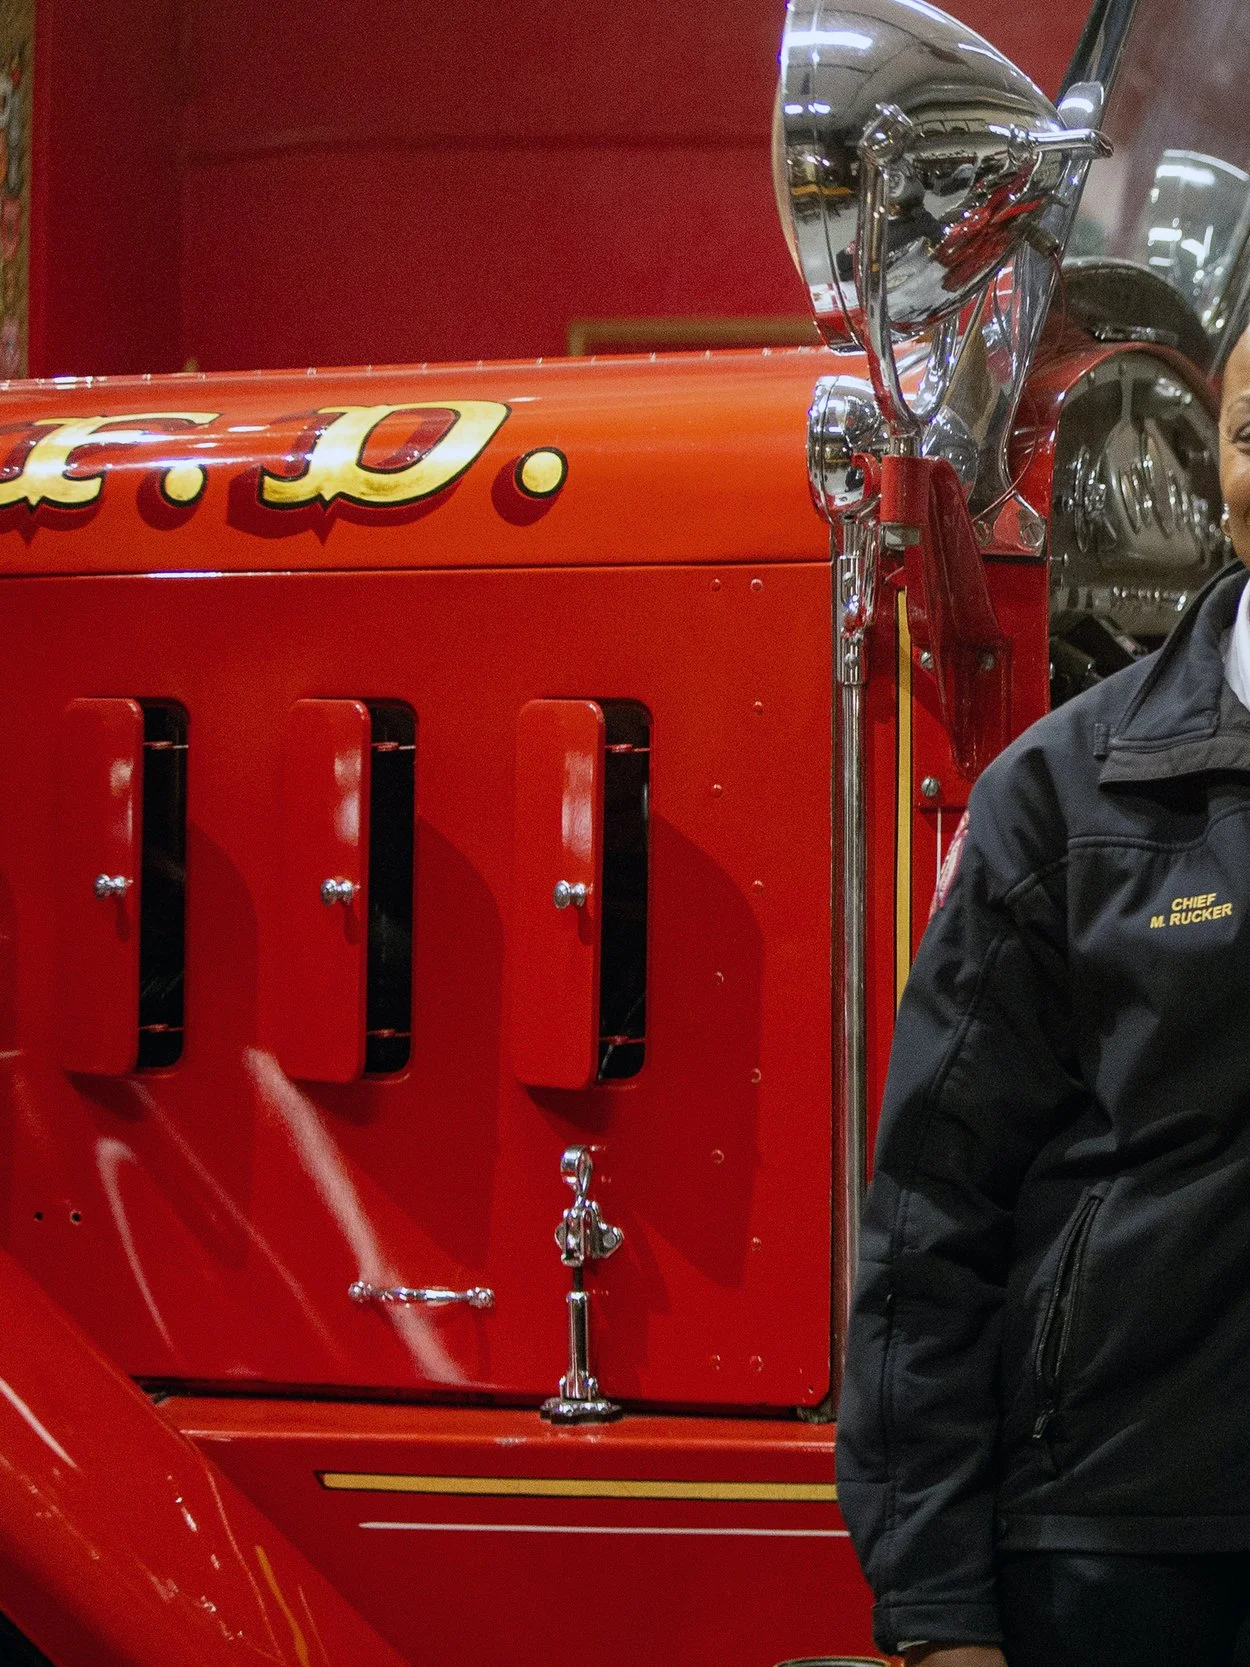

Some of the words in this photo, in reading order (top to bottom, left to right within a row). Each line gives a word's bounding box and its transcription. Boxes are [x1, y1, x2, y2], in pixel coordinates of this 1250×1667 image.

[1171, 892, 1217, 911] CHIEF
[1149, 915, 1166, 929] M.
[1169, 902, 1233, 926] RUCKER
